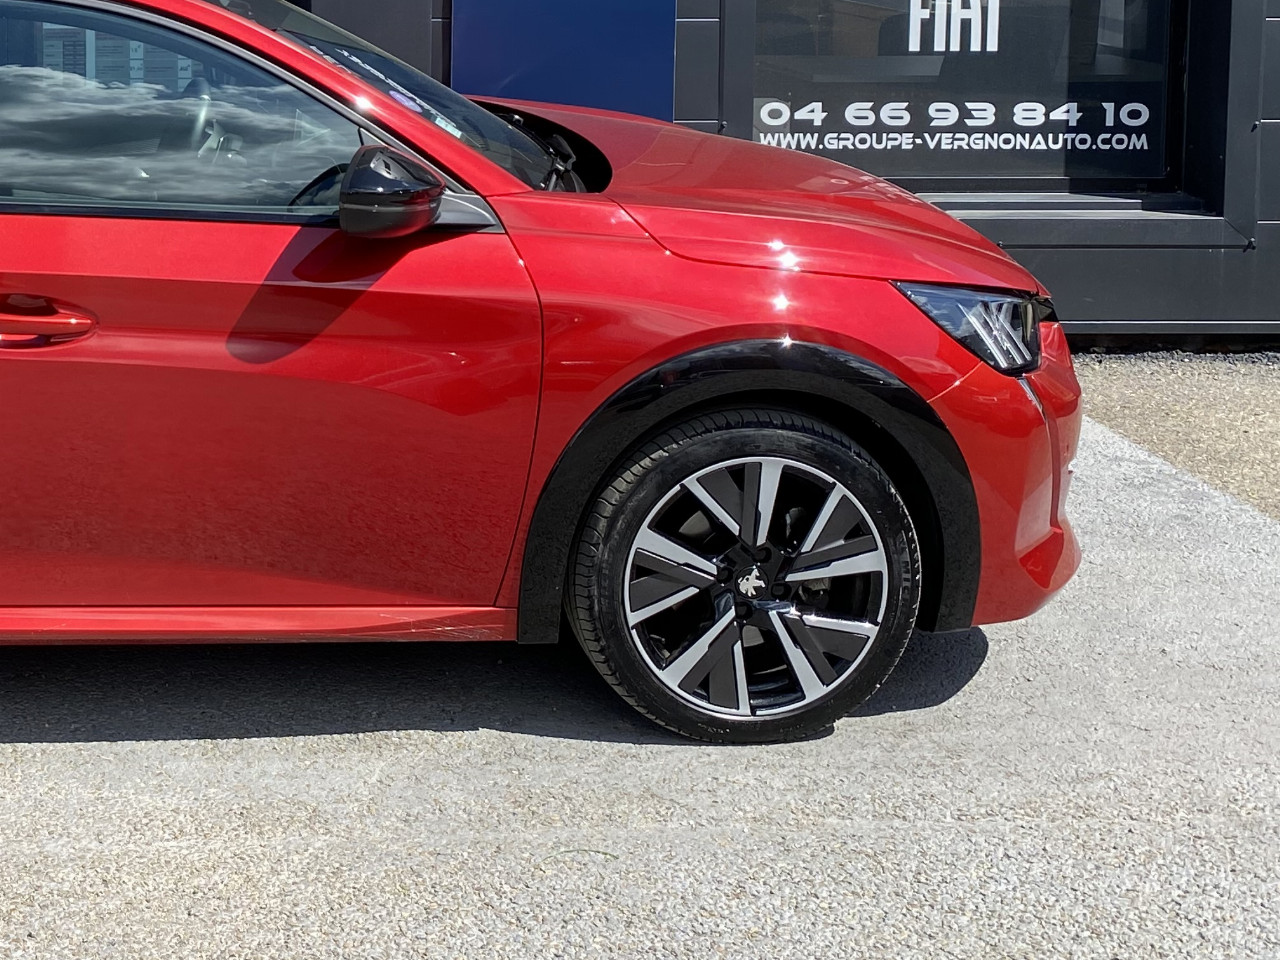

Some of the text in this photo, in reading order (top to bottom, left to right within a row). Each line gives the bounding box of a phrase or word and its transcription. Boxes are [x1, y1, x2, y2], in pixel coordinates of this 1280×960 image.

[759, 101, 1150, 127] 04 66 93 84 10
[759, 132, 1149, 150] WWW.GROUPE-VERGNONAUTO.COM
